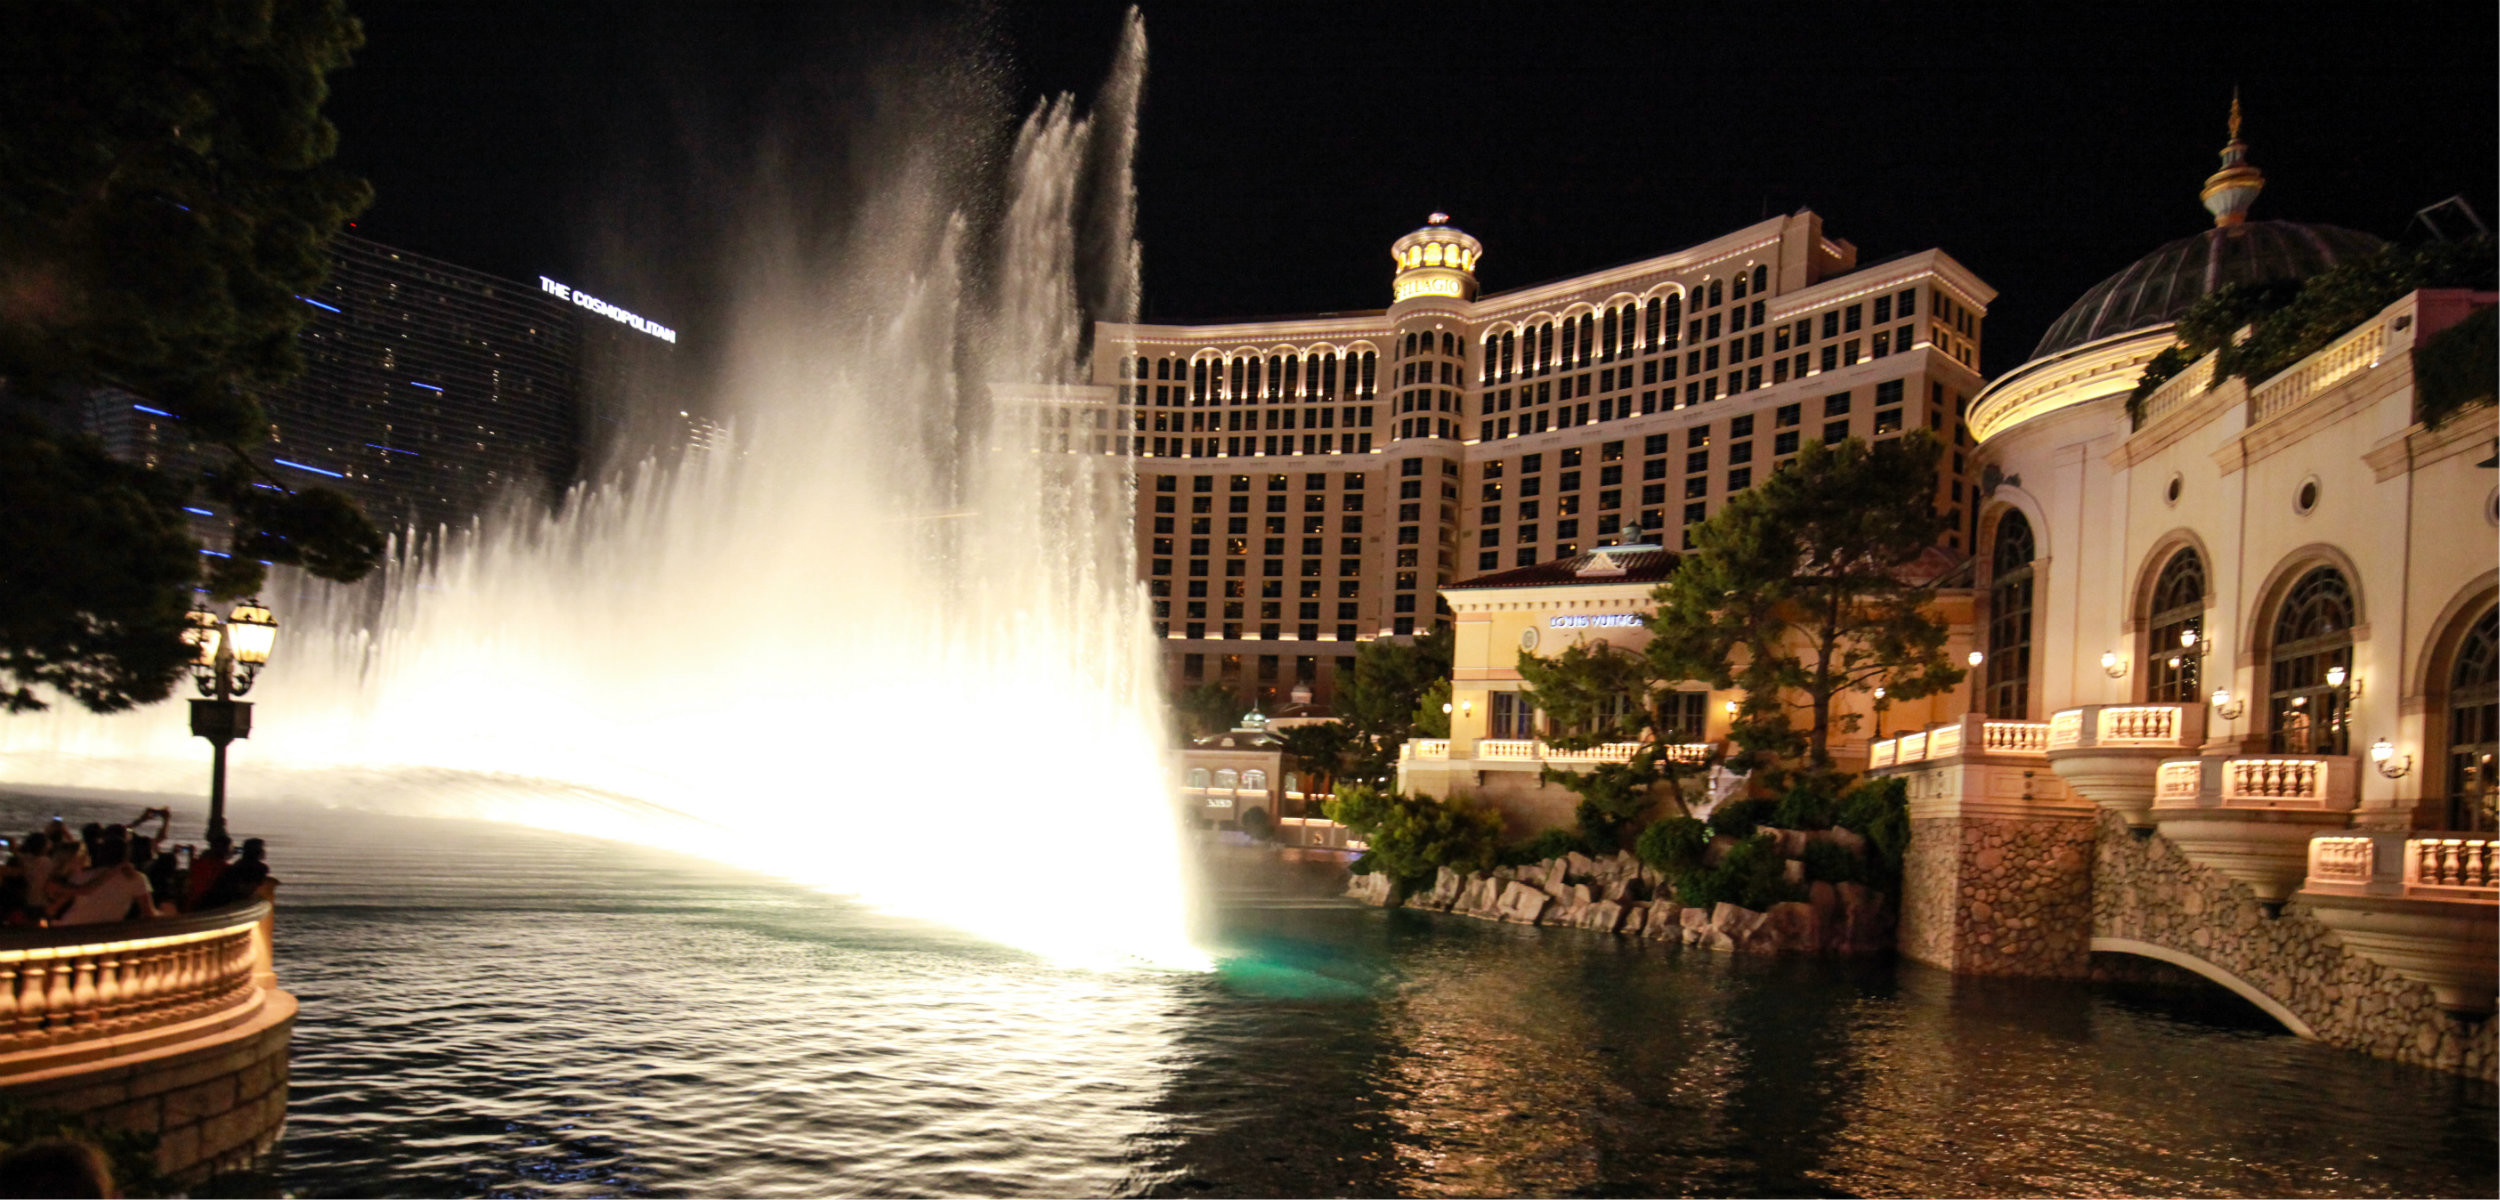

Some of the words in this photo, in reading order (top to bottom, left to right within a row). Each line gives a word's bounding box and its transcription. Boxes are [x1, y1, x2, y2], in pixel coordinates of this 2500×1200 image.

[539, 275, 571, 301] THE
[572, 290, 677, 344] COSMOPOLITAN
[1550, 615, 1590, 628] LOUIS
